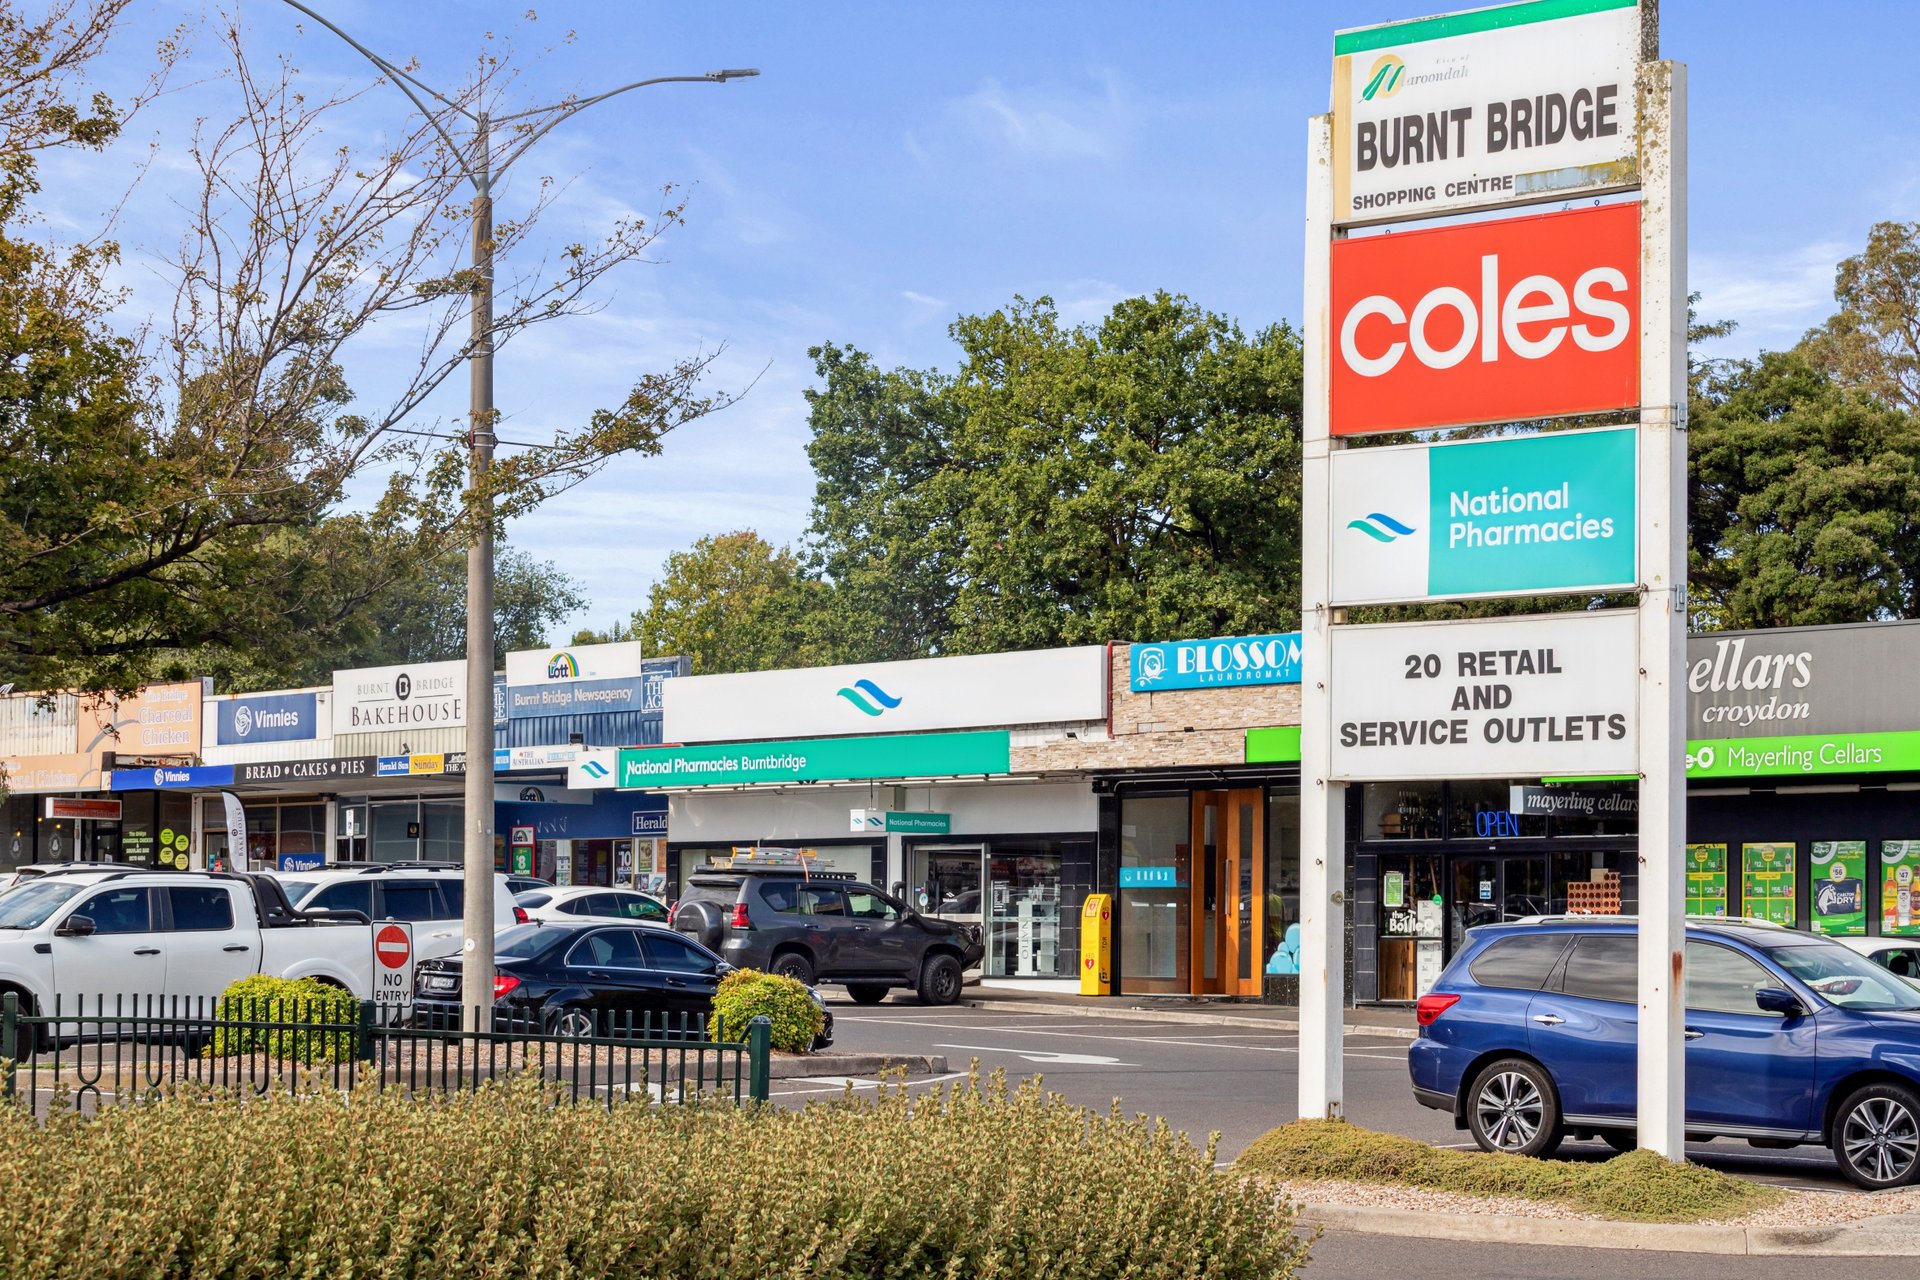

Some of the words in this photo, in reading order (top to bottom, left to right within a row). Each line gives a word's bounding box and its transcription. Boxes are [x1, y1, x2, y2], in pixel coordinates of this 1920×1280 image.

[1357, 106, 1473, 172] BURNT
[1487, 84, 1618, 154] BRIDGE
[1353, 185, 1436, 210] SHOPPING
[1445, 174, 1513, 197] CENTRE
[1340, 254, 1630, 377] coles
[1449, 482, 1568, 517] National
[1449, 513, 1614, 548] Pharmacies
[1405, 653, 1441, 679] 20
[1458, 648, 1562, 677] RETAIL
[1686, 638, 1812, 693] ellars
[1200, 669, 1290, 682] LAUNDROMAT
[357, 682, 389, 696] BURNT
[416, 677, 454, 691] BRIDGE
[514, 693, 540, 706] Burnt
[542, 690, 571, 706] Bridge
[574, 687, 633, 703] Newsagency
[1451, 684, 1512, 711] AND
[139, 704, 193, 725] Charcoal
[255, 709, 299, 729] Vinnies
[352, 699, 462, 727] BAKEHOUSE
[1702, 696, 1810, 727] croydon
[142, 728, 191, 747] Chicken
[1340, 719, 1468, 747] SERVICE
[1483, 713, 1626, 744] OUTLETS
[379, 761, 397, 771] Herald
[398, 761, 408, 770] Sun
[414, 759, 438, 771] Sunday
[627, 759, 672, 775] National
[674, 756, 738, 773] Pharmacies
[741, 753, 806, 772] Burntbridge
[1728, 744, 1813, 772] Mayerling
[1819, 742, 1882, 765] Cellars
[165, 770, 190, 783] Vinnies
[246, 765, 281, 780] BREAD
[293, 762, 328, 777] CAKES
[341, 760, 365, 774] PIES
[1527, 791, 1596, 814] mayerling
[1598, 793, 1640, 812] cellars
[635, 816, 667, 831] Herald
[889, 818, 913, 826] National
[914, 820, 947, 828] Pharmacies
[1476, 811, 1519, 837] OPEN
[1836, 897, 1854, 905] DRY
[1391, 910, 1404, 920] the
[383, 973, 403, 986] NO
[376, 990, 410, 1001] ENTRY
